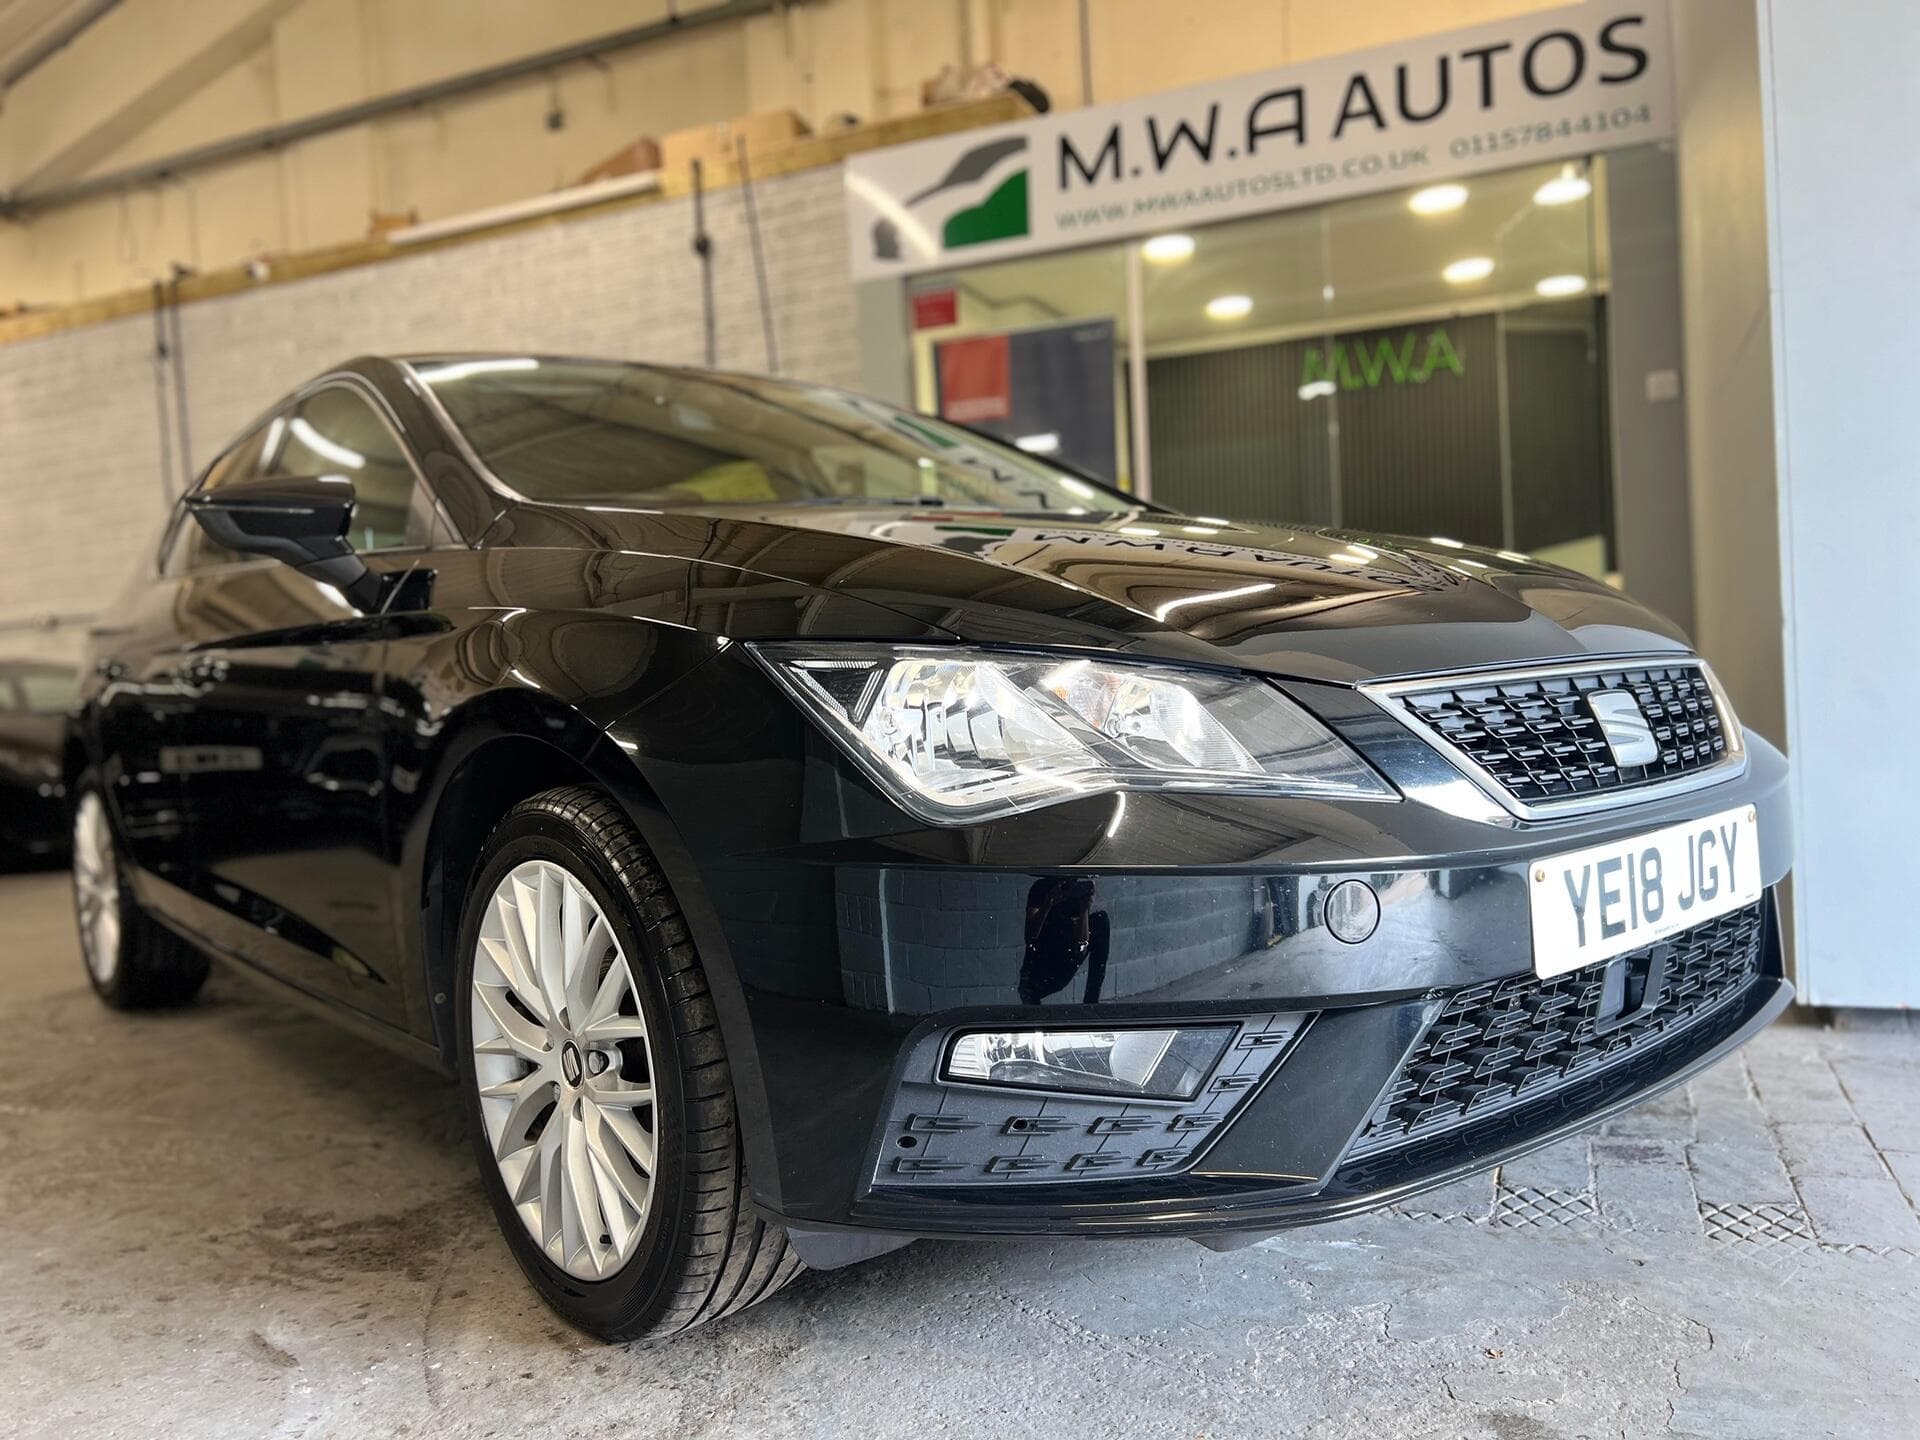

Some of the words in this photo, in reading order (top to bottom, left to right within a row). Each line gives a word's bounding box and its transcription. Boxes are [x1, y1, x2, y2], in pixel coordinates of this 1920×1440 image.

[1058, 84, 1305, 191] M.W.A
[1331, 14, 1649, 139] AUTOS
[1448, 104, 1650, 158] 01157844104
[1563, 846, 1665, 948] YE18
[1677, 821, 1738, 911] JGY
